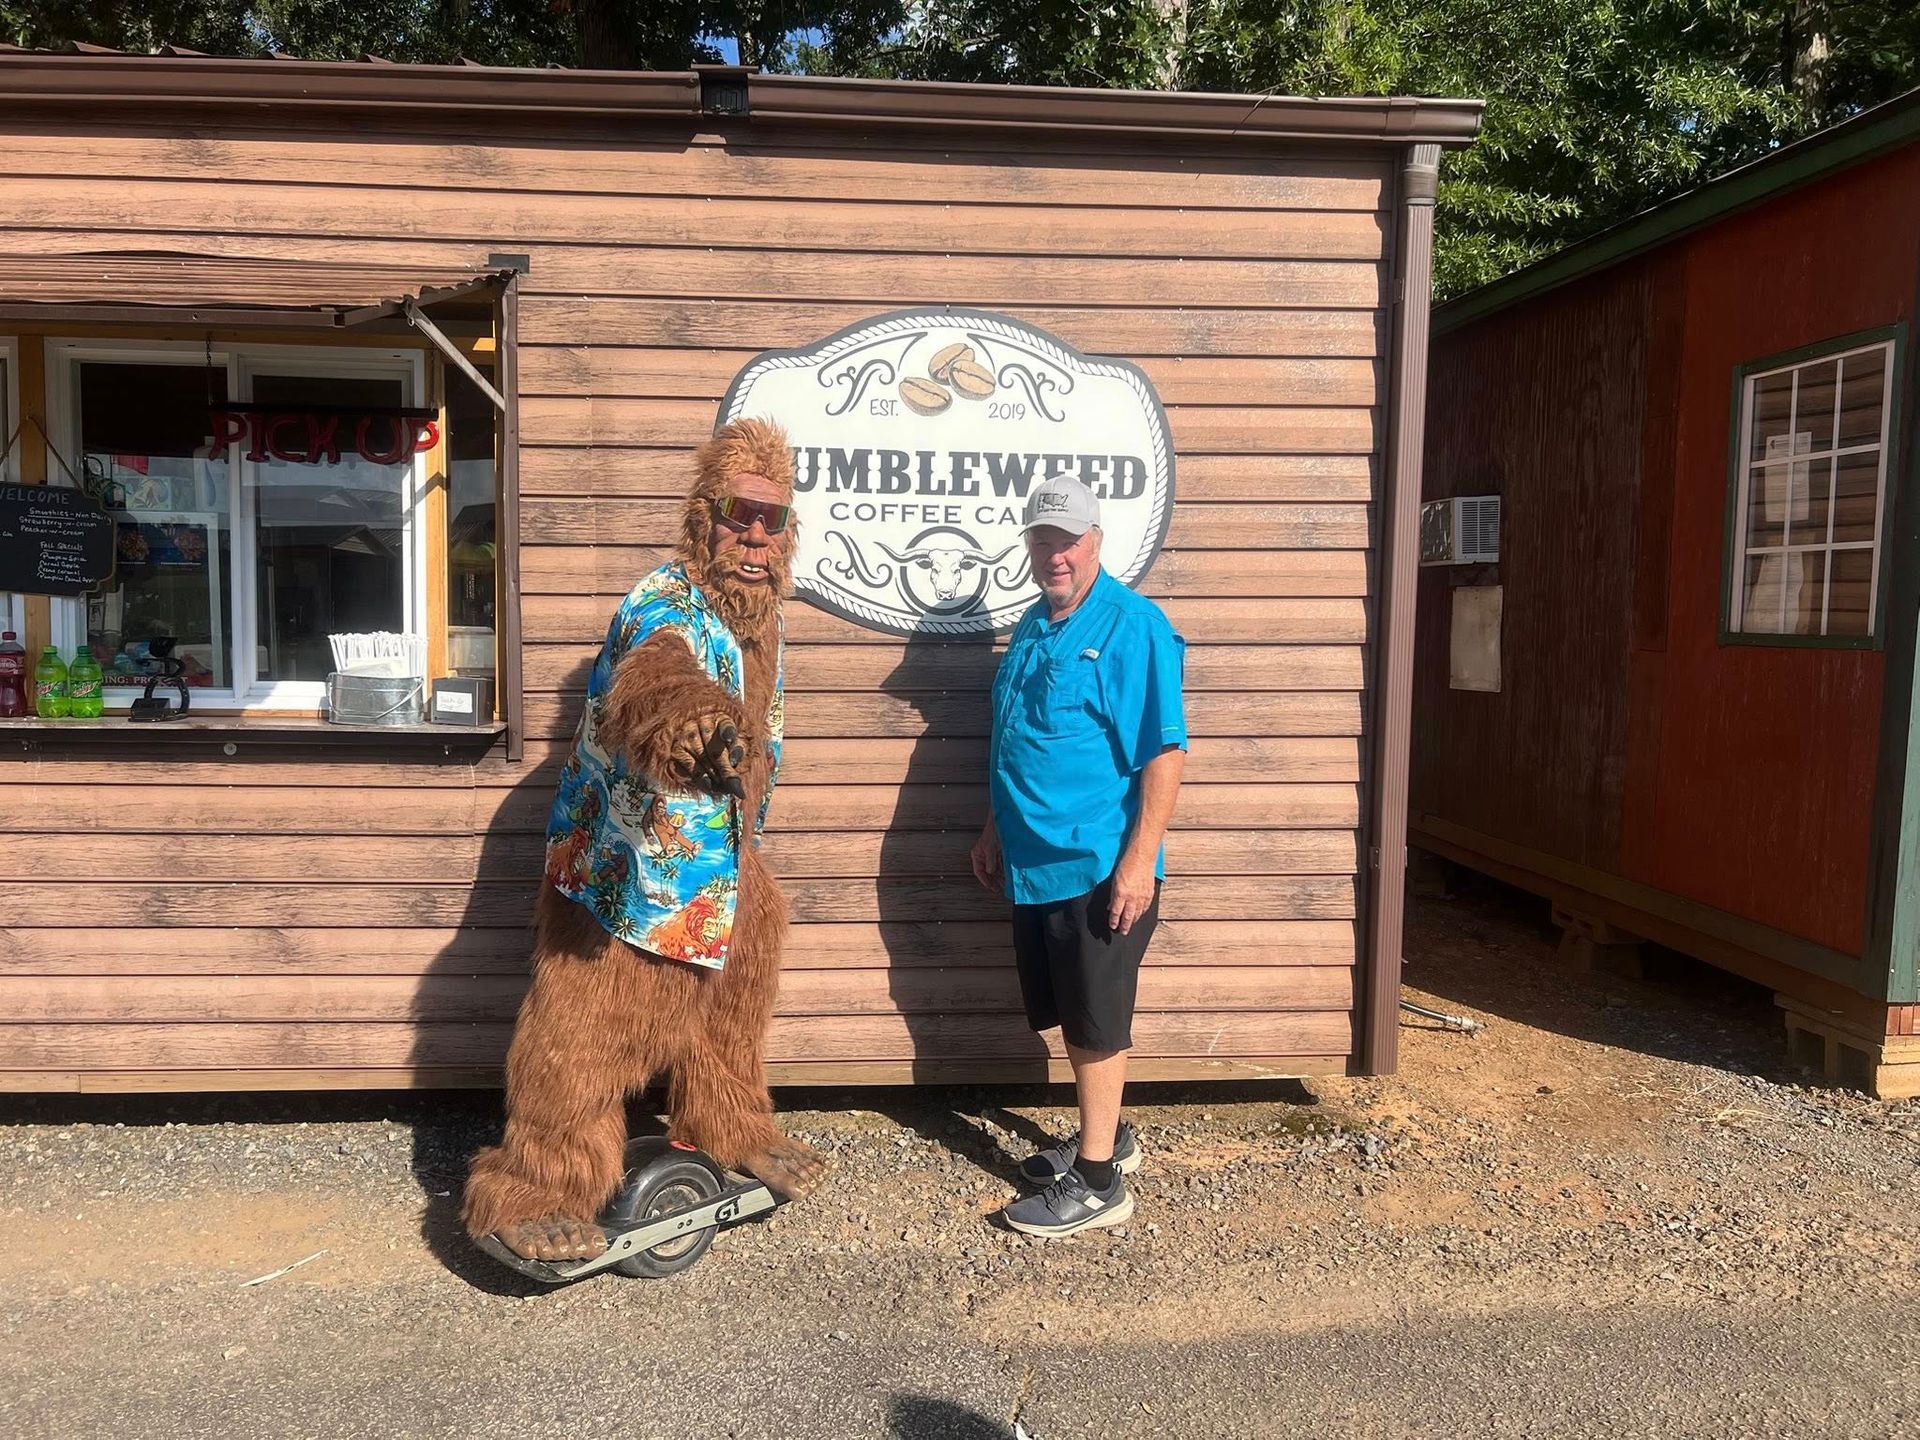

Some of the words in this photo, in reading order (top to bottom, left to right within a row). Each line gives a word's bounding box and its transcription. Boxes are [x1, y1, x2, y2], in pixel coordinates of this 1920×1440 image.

[870, 398, 899, 417] EST.
[988, 402, 1026, 421] 2019
[208, 412, 342, 465] PICK
[355, 414, 440, 466] UP
[787, 446, 1150, 500] UMBLEWEED
[830, 502, 960, 524] COFFEE
[101, 675, 129, 685] ING:
[714, 1195, 742, 1224] GT
